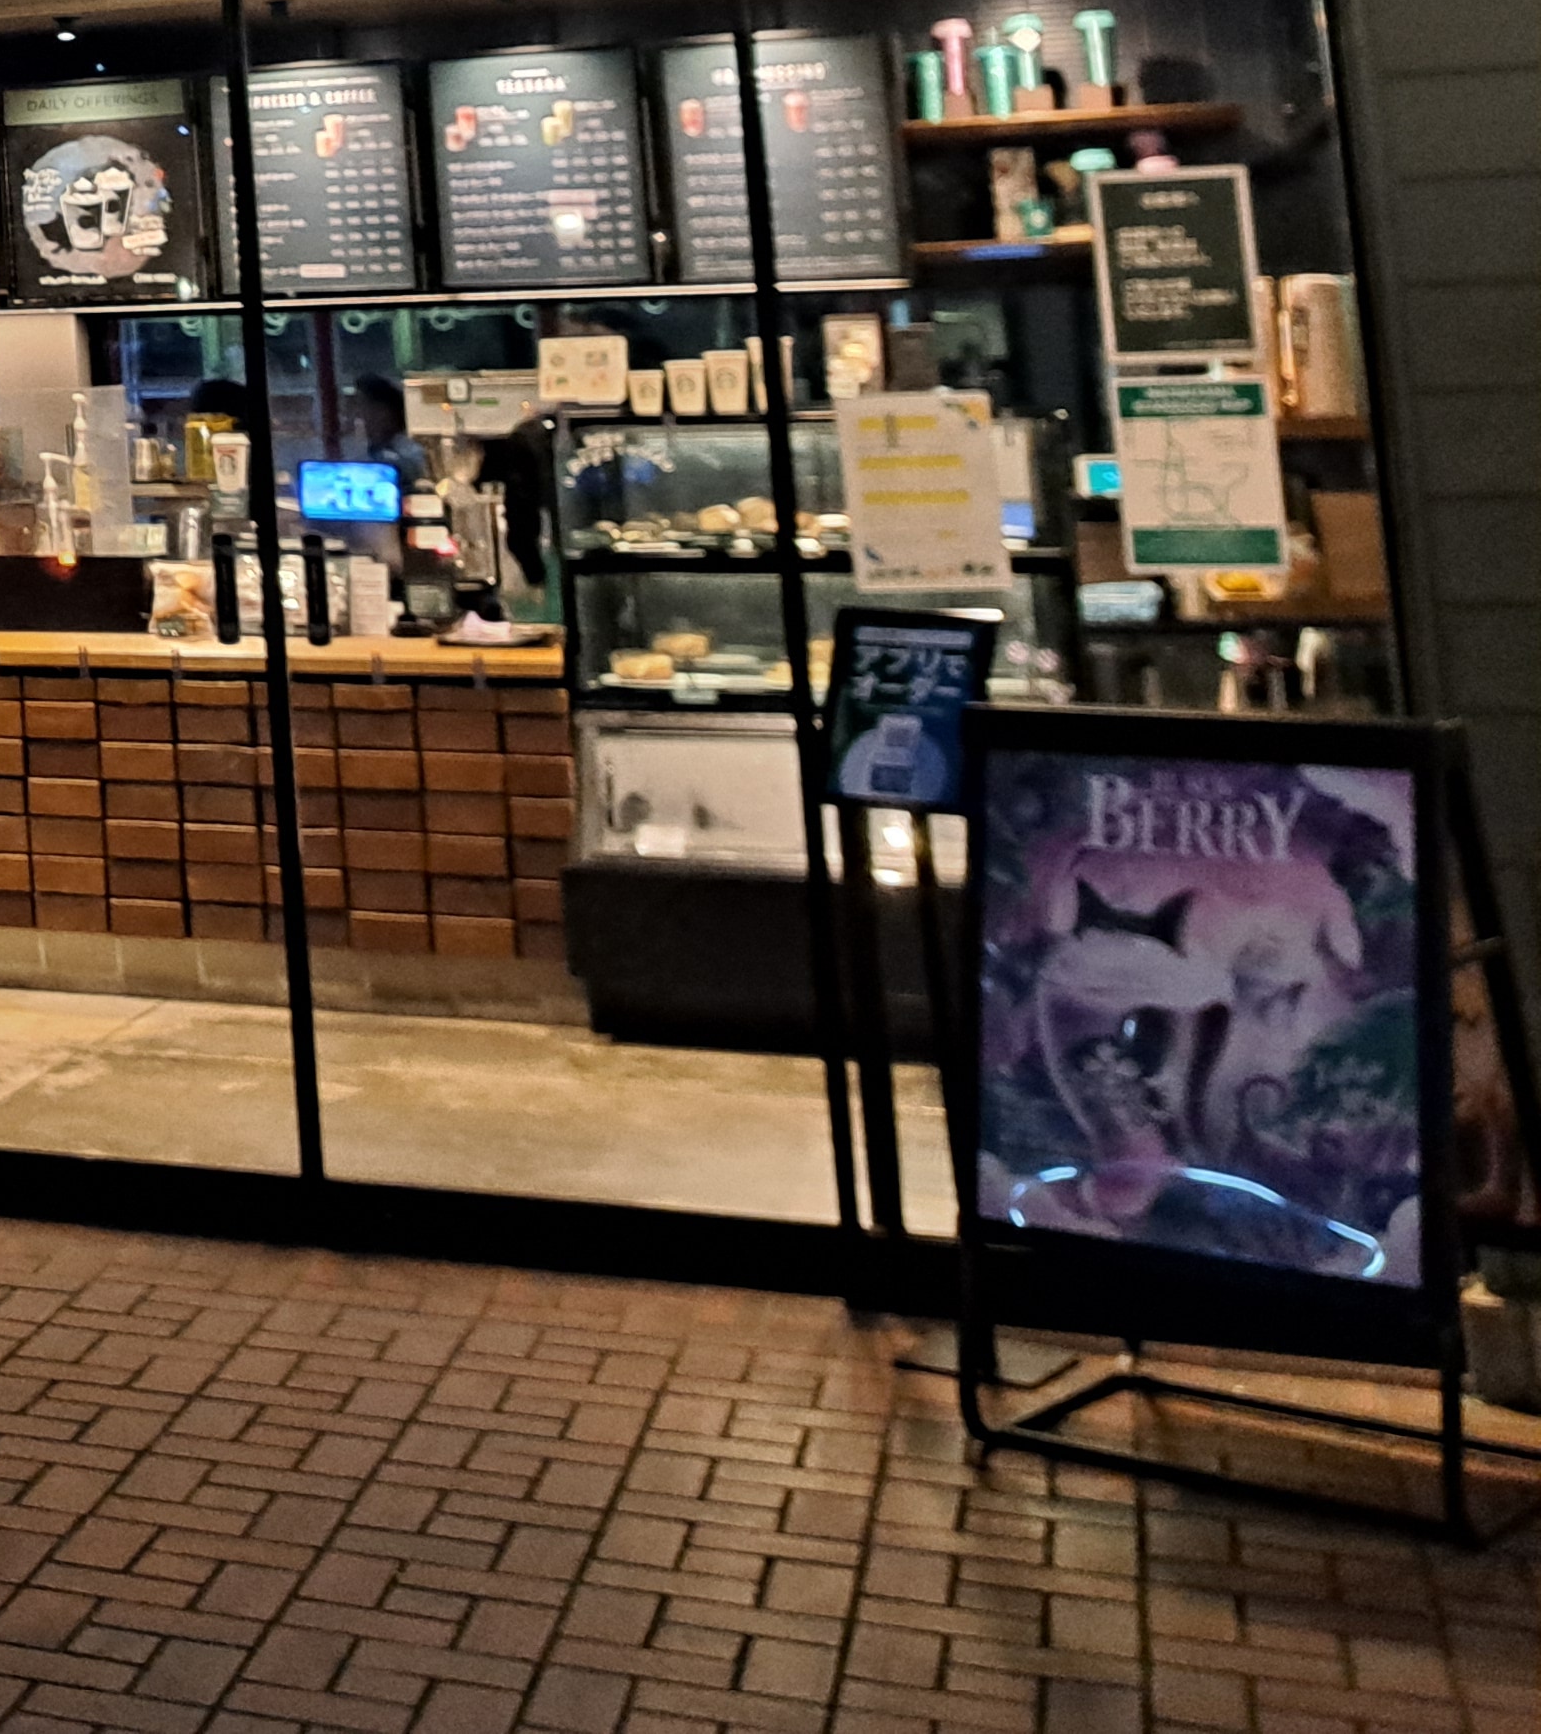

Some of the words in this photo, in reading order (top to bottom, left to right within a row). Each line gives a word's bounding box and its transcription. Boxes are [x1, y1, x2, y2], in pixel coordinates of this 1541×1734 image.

[27, 96, 69, 112] DAILY
[74, 92, 159, 109] OFFERINGS
[1081, 772, 1307, 863] BERRY
